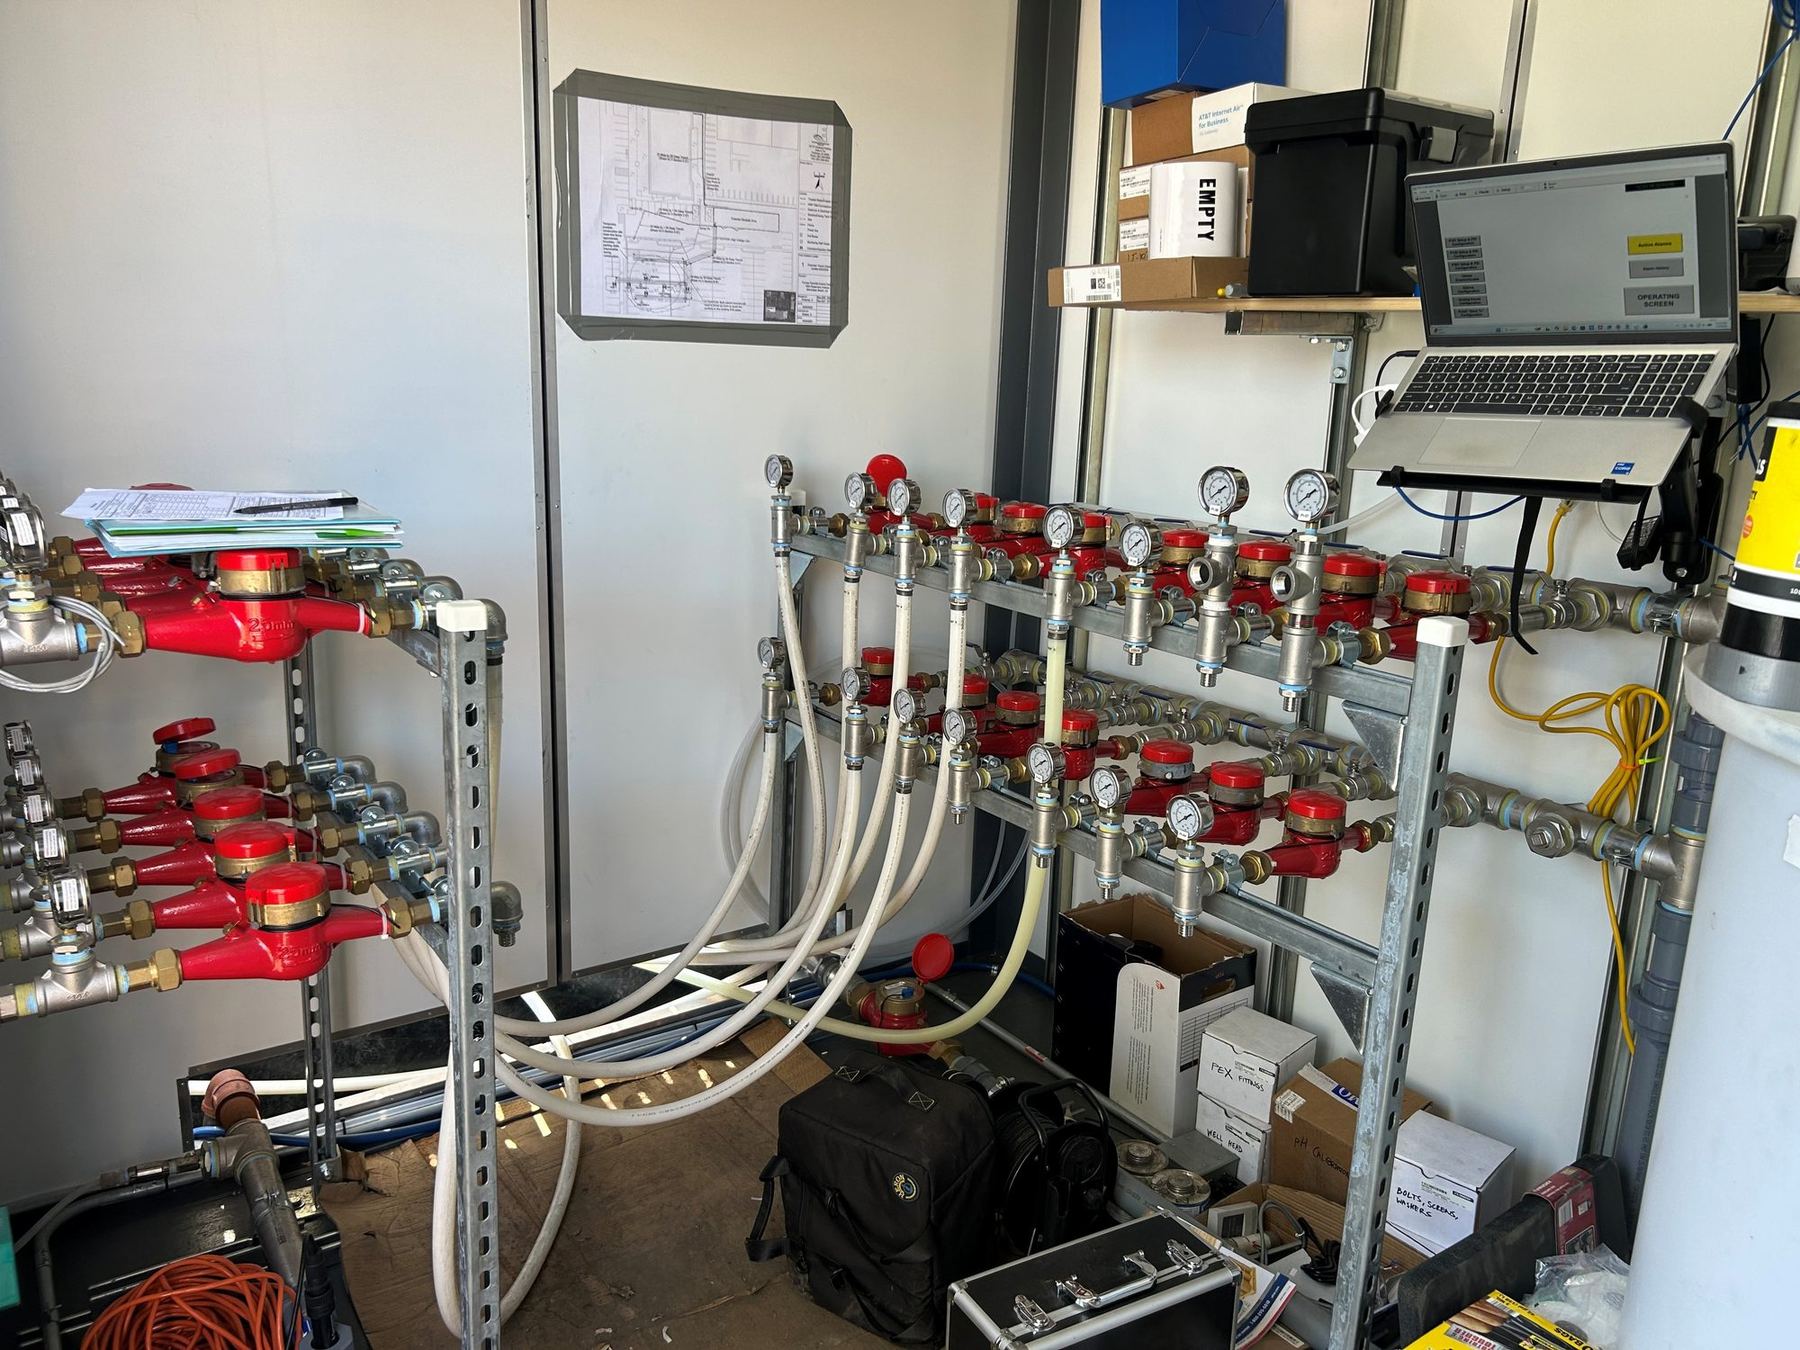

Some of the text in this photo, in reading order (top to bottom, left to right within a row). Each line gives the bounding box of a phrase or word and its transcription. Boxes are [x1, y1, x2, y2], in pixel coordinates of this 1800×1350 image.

[1198, 117, 1229, 129] for Business
[1199, 111, 1211, 121] AT&T
[1211, 107, 1232, 118] Internet
[1197, 178, 1217, 241] EMPTY
[1637, 293, 1680, 301] OPERATING
[1211, 1062, 1234, 1081] PEX
[1206, 1128, 1243, 1153] WELL HEAD
[1293, 1136, 1309, 1149] pH
[1396, 1186, 1425, 1206] BOLTS,
[1395, 1196, 1433, 1218] WASHERS
[1554, 1327, 1583, 1347] BAGS
